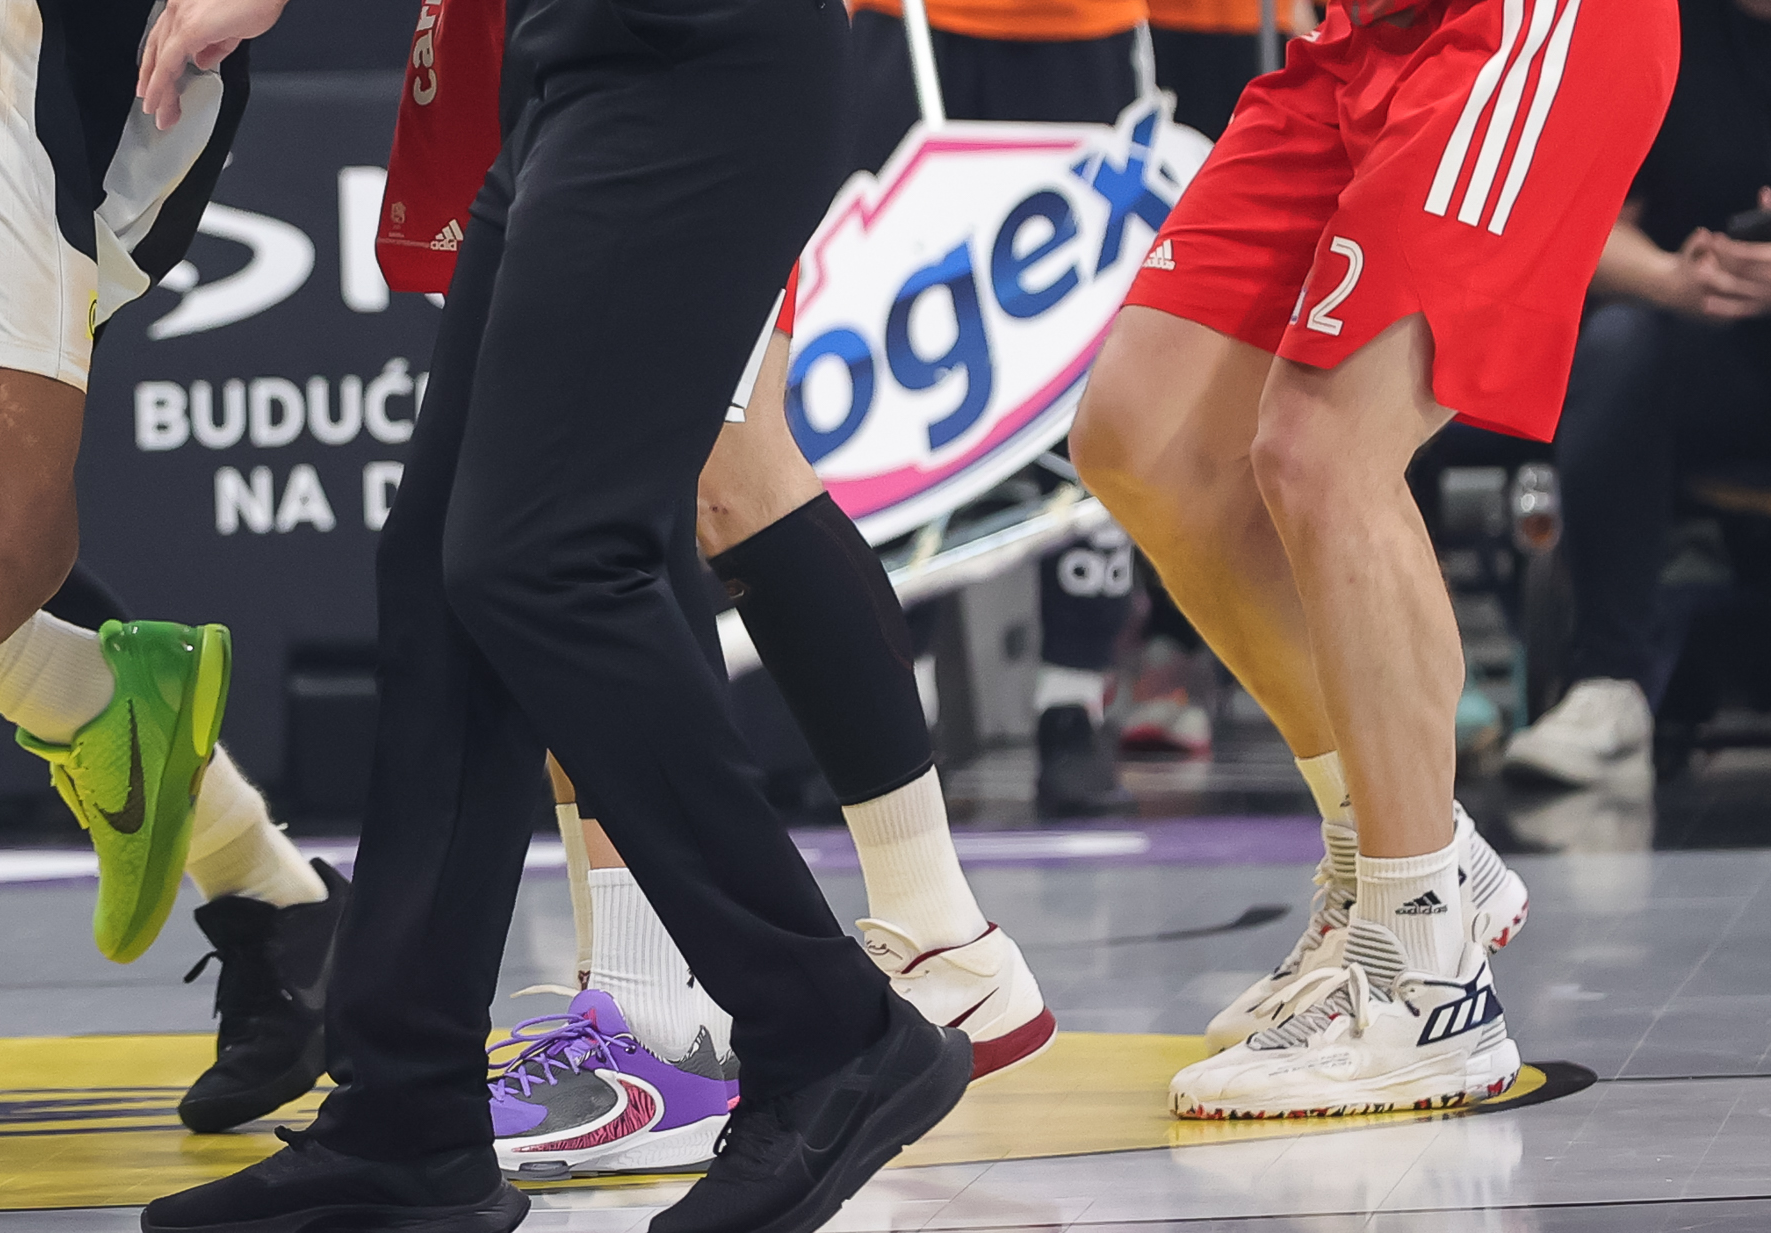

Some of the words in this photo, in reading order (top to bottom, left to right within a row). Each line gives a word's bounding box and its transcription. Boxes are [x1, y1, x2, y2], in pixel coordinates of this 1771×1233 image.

[784, 109, 1171, 466] ogex
[133, 356, 429, 452] BUDUĆ
[213, 463, 337, 537] NA
